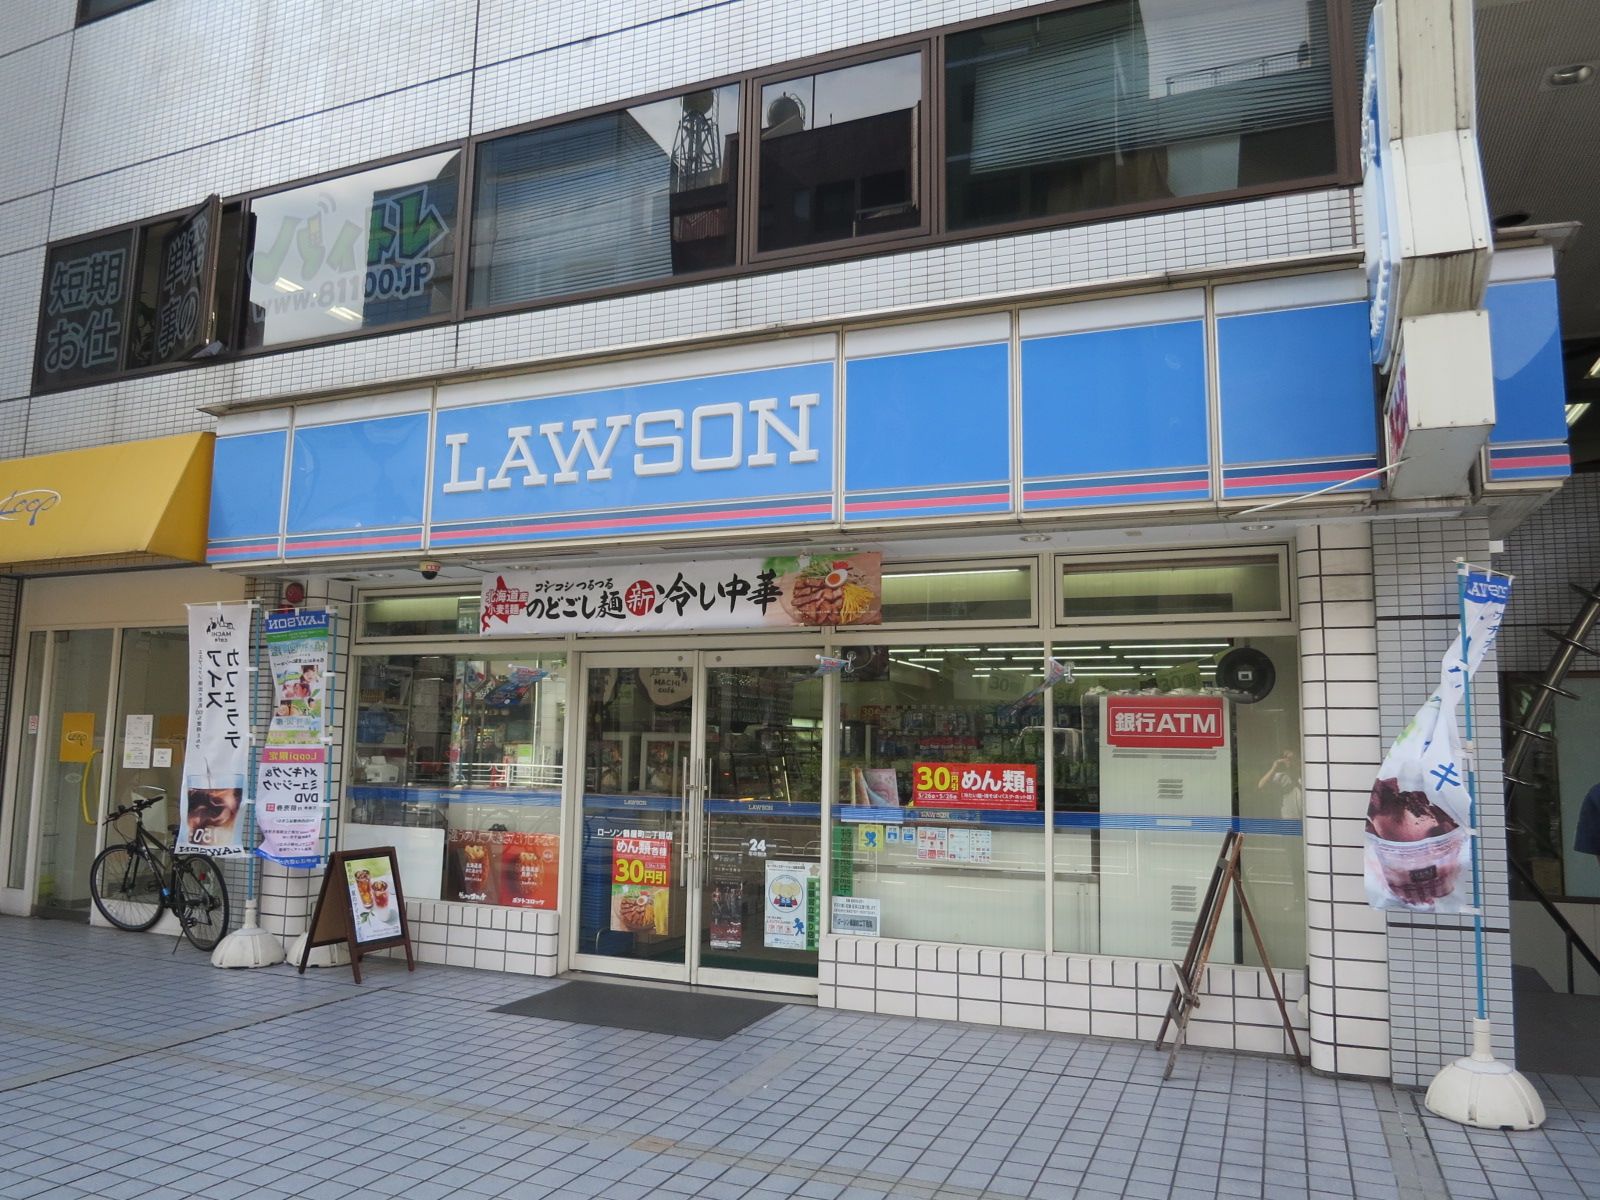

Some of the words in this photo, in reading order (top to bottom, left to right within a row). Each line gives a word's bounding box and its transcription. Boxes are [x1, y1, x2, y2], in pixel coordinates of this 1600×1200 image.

[48, 248, 126, 316] 短期
[442, 393, 821, 493] LAWSON
[527, 589, 626, 620] のどごし麺
[627, 582, 654, 614] 新
[655, 568, 783, 617] 冷し中華
[653, 678, 681, 687] MACHI
[1115, 712, 1216, 733] 銀行ATM
[917, 766, 951, 791] 30
[961, 769, 1025, 793] めん類
[616, 840, 650, 855] めん類
[749, 838, 767, 852] 24
[615, 858, 644, 883] 30
[644, 870, 667, 885] 円引
